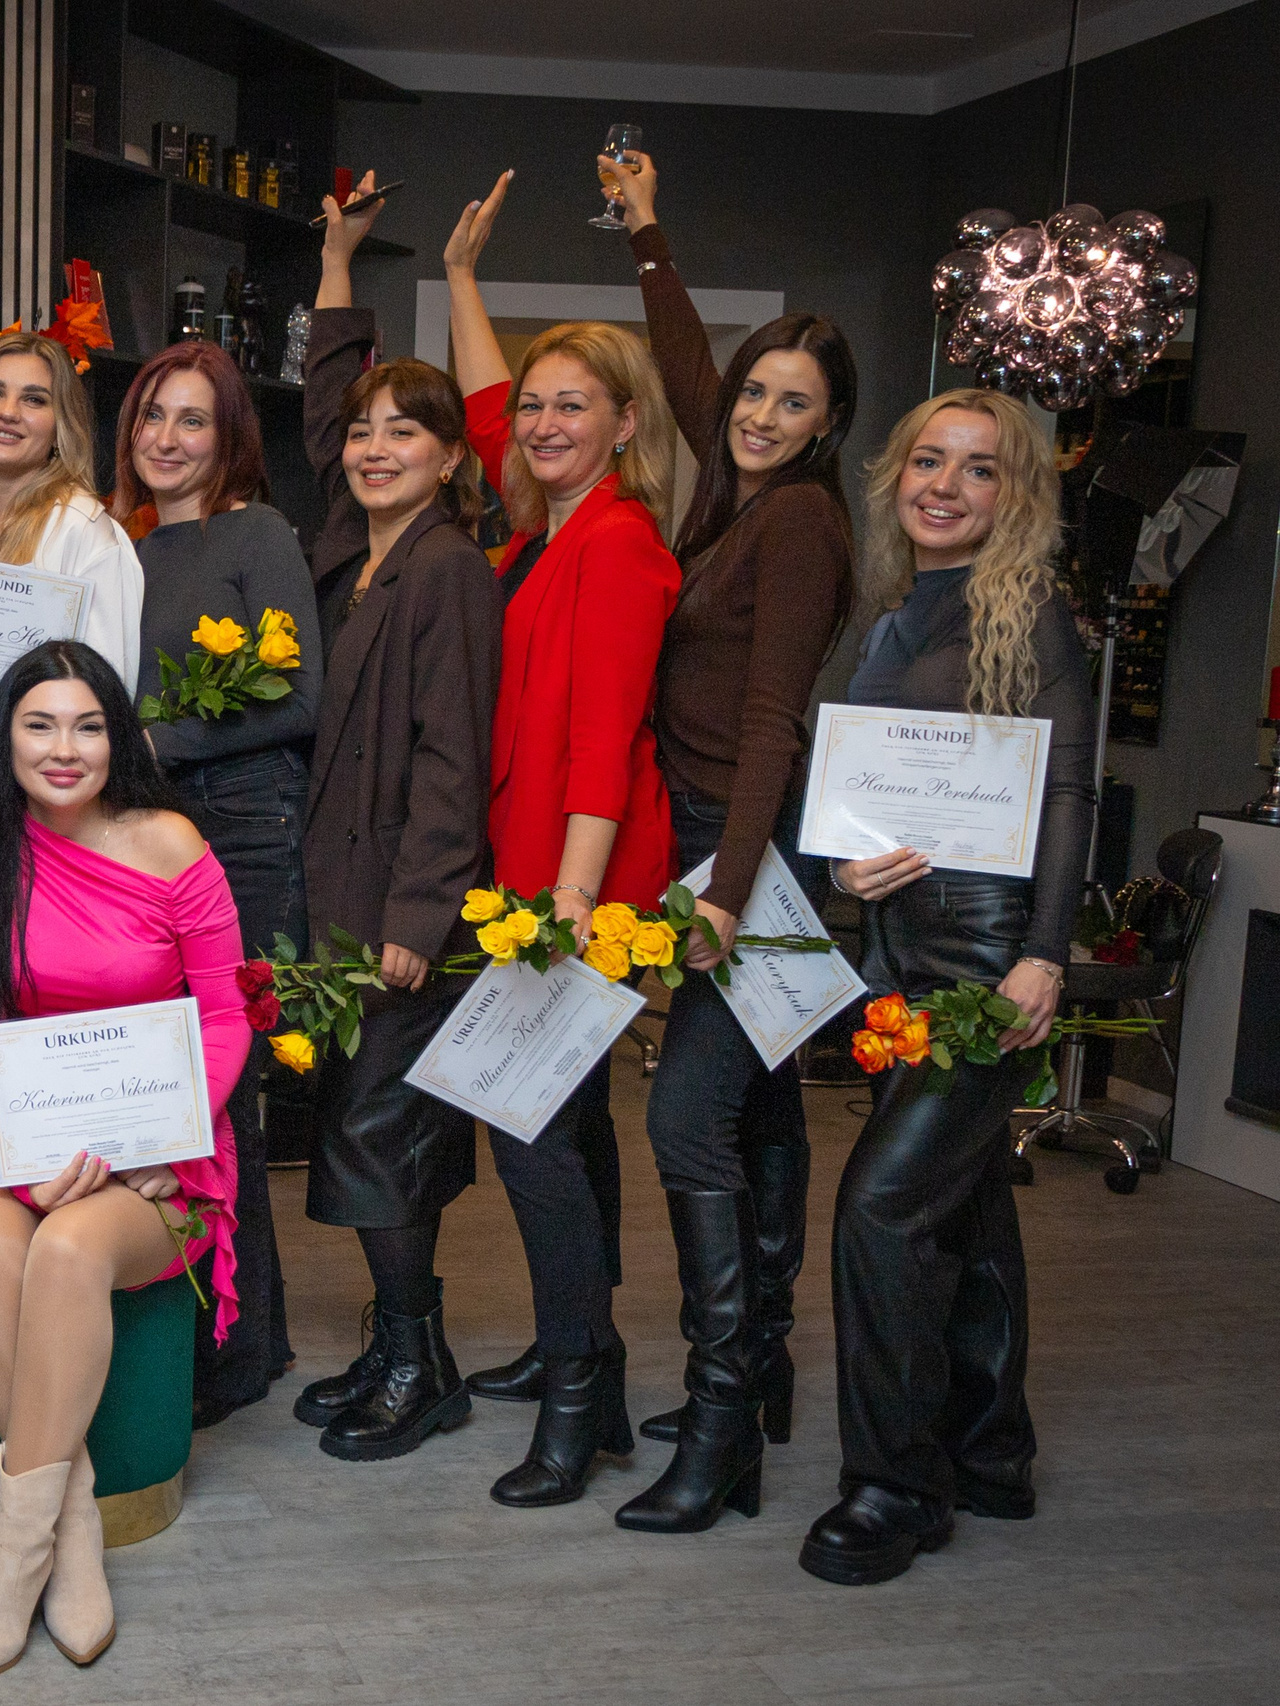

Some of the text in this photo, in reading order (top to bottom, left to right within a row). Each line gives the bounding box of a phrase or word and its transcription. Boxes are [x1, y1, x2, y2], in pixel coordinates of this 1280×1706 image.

[887, 725, 973, 745] URKUNDE
[845, 771, 1013, 804] Hanna Perehuda
[773, 884, 811, 937] URKUN
[452, 986, 502, 1046] URKUNDE
[44, 1026, 129, 1049] URKUNDE
[470, 1048, 515, 1096] Uliana
[9, 1076, 181, 1113] Katerina Nikitina
